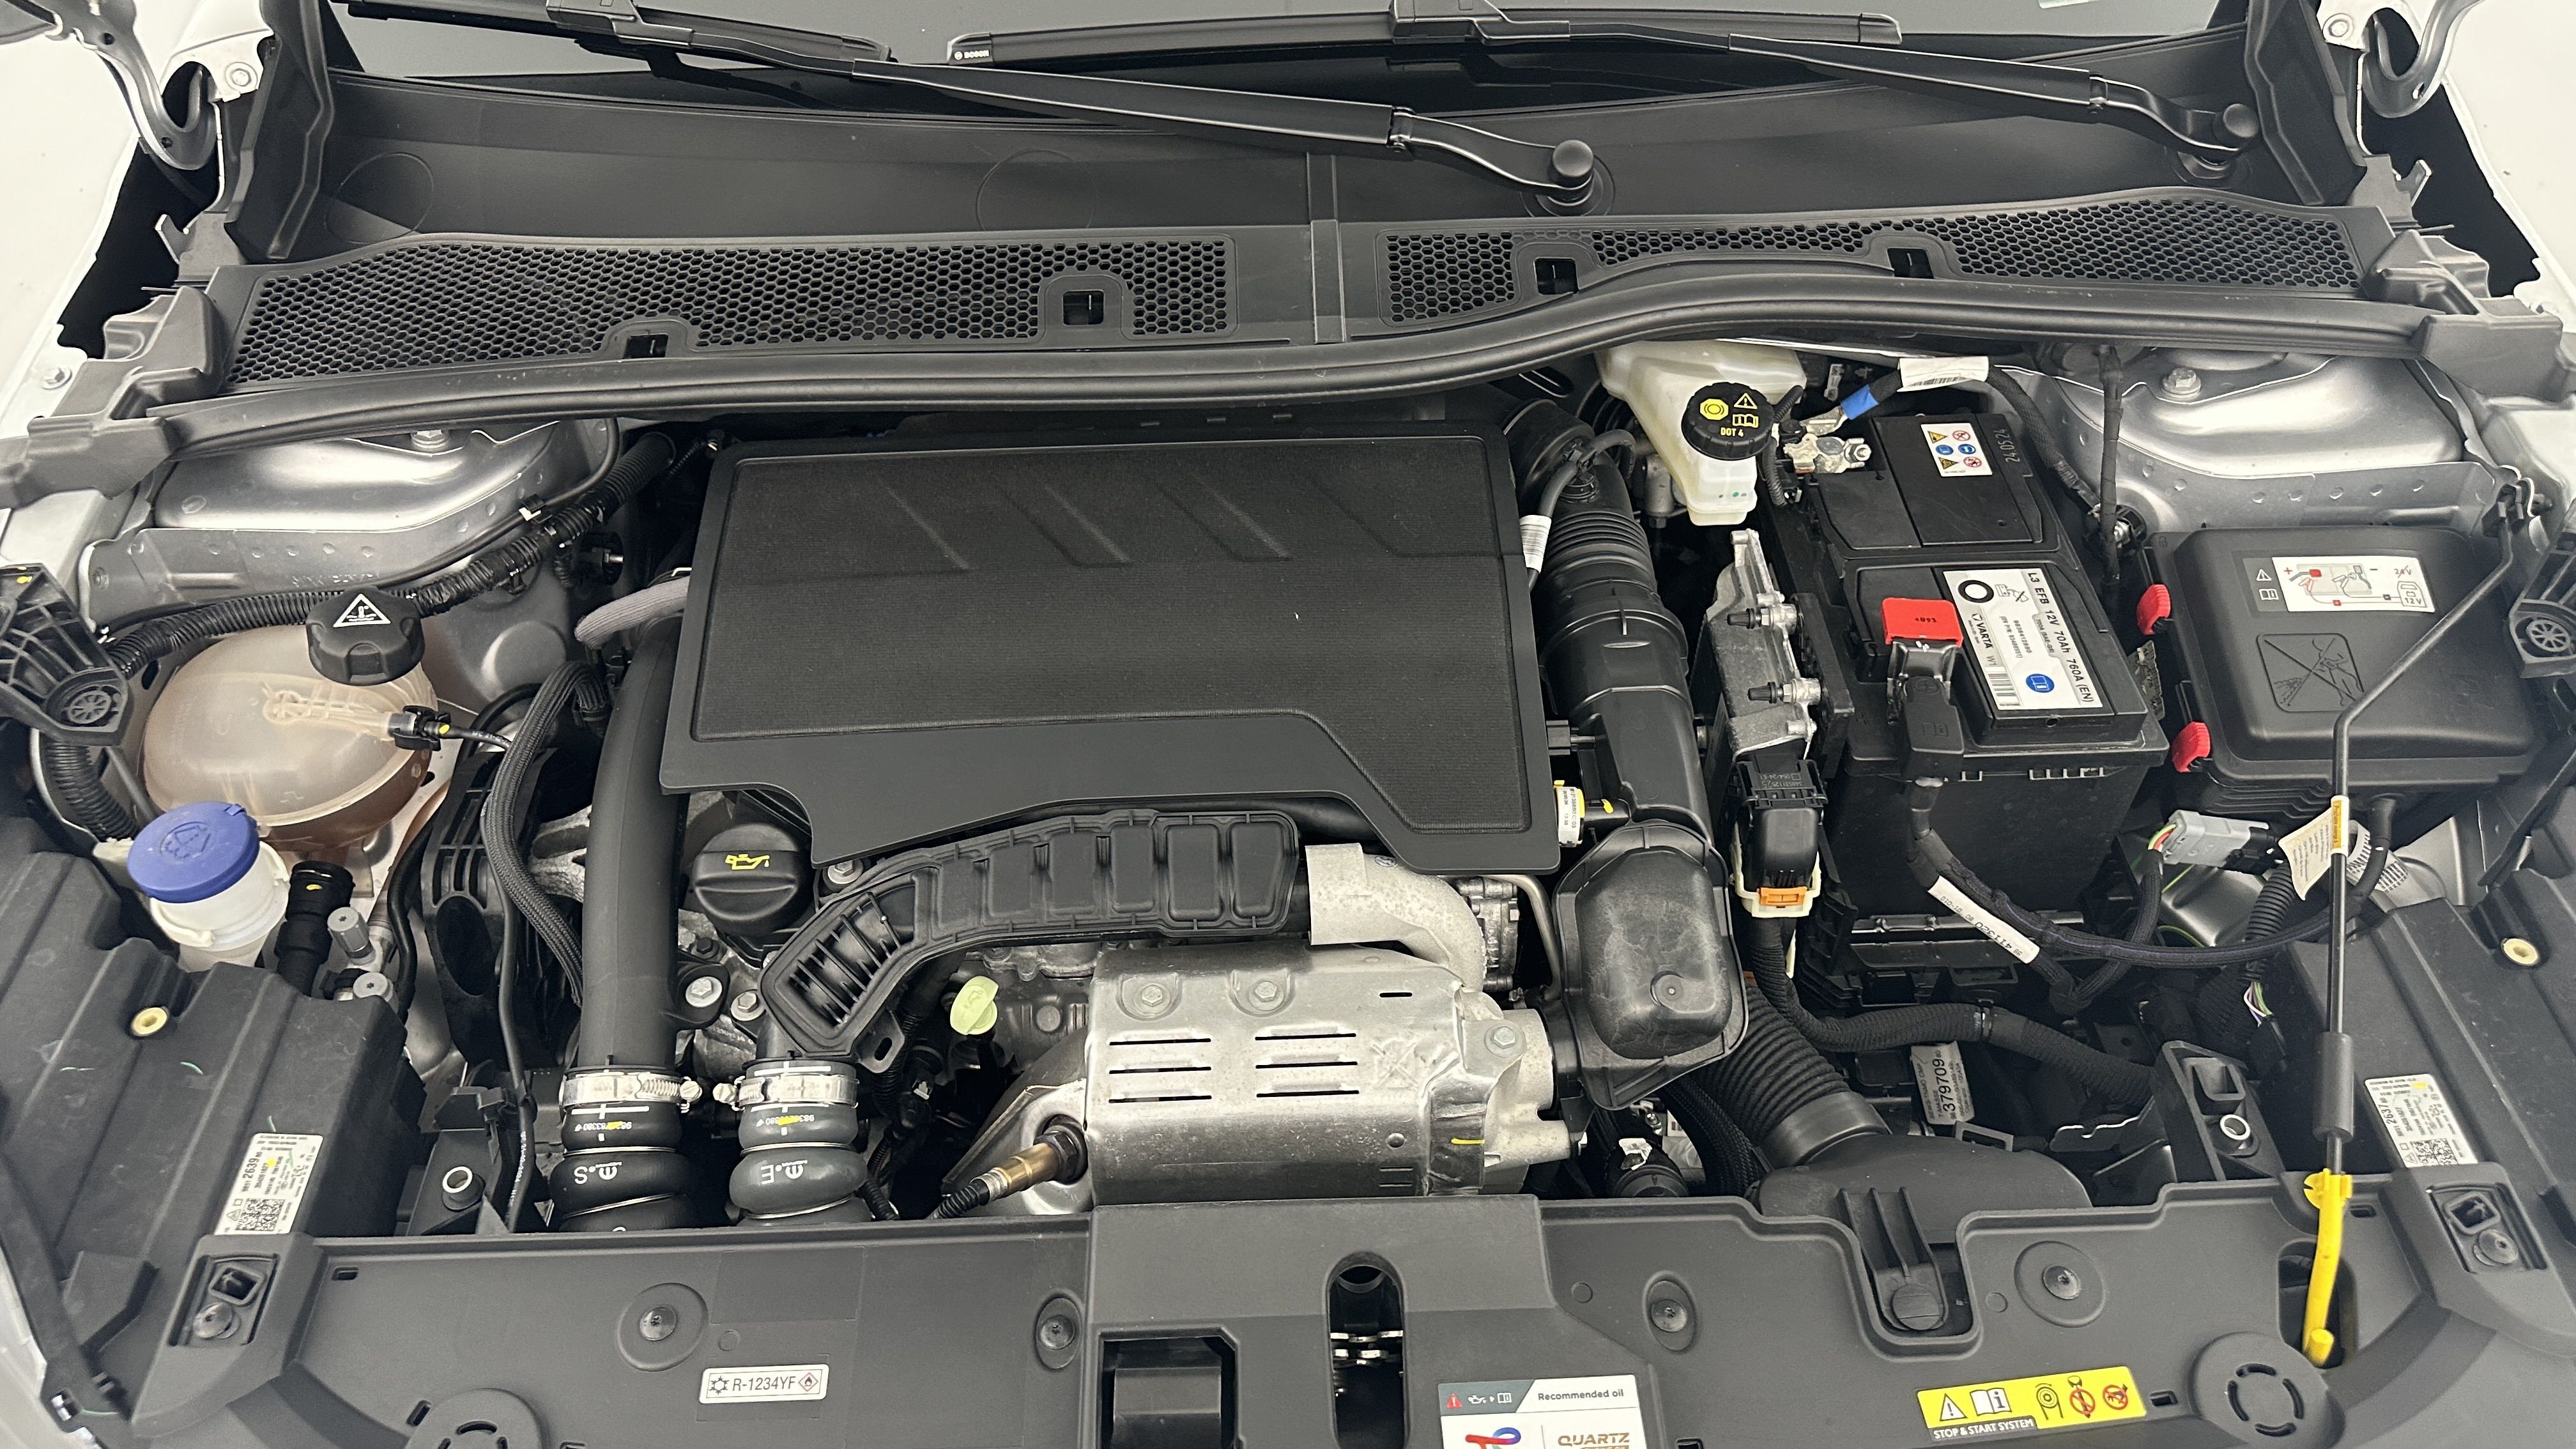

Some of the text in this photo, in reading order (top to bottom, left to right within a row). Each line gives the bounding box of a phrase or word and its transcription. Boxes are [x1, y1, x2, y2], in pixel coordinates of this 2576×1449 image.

[964, 50, 989, 58] BOSCH
[1721, 427, 1744, 437] DOT 4
[1975, 622, 1993, 648] VARTA
[2027, 572, 2094, 702] L3 EFB 12V 70Ah 760A (EN)
[1931, 1057, 1956, 1112] 379709
[2378, 1103, 2396, 1124] 2637
[241, 1158, 259, 1178] 2639
[732, 1376, 796, 1391] R-1234YF
[1538, 1390, 1609, 1400] Recommended
[1558, 1432, 1630, 1446] QUARTZ
[1934, 1419, 2034, 1439] STOP & START SYSTEM
